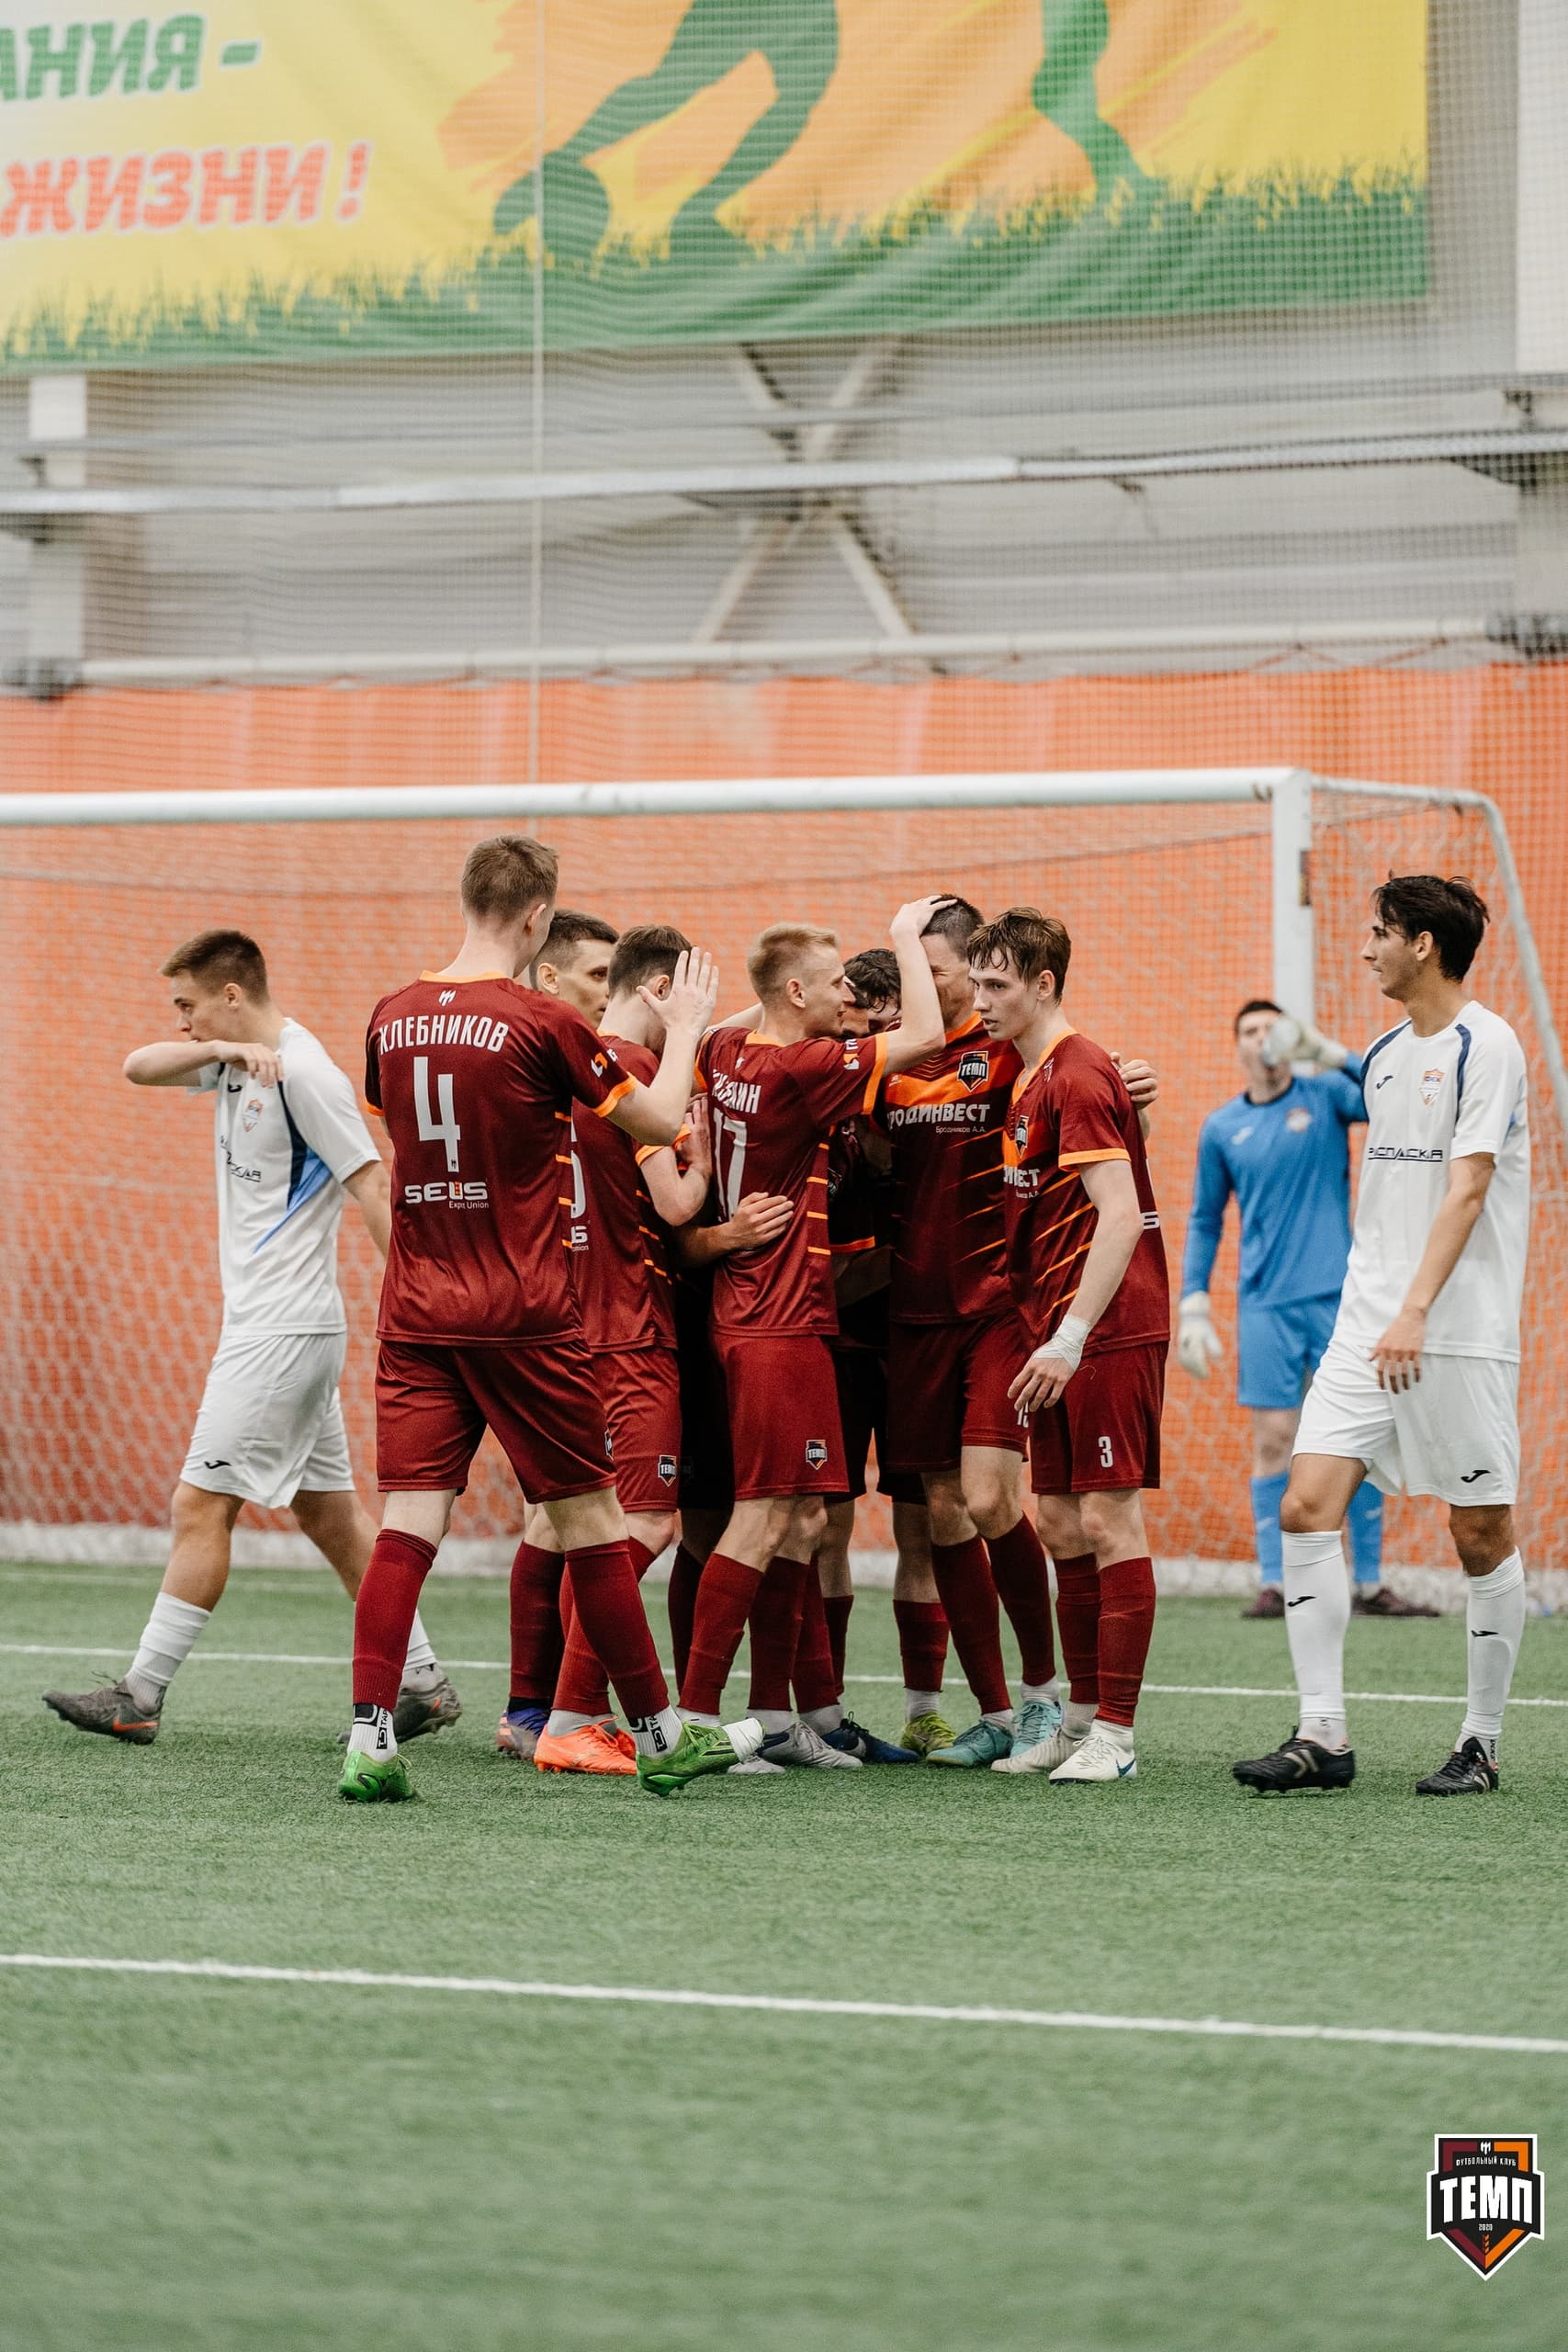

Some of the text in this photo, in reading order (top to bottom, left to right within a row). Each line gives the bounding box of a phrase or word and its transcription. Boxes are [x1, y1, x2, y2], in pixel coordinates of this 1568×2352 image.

[379, 1014, 509, 1056] ХЛЕБНИКОВ
[413, 1057, 461, 1172] 4
[713, 1107, 748, 1222] 17
[404, 1181, 488, 1204] SEUS
[467, 1201, 489, 1209] Union
[1098, 1435, 1113, 1468] 3
